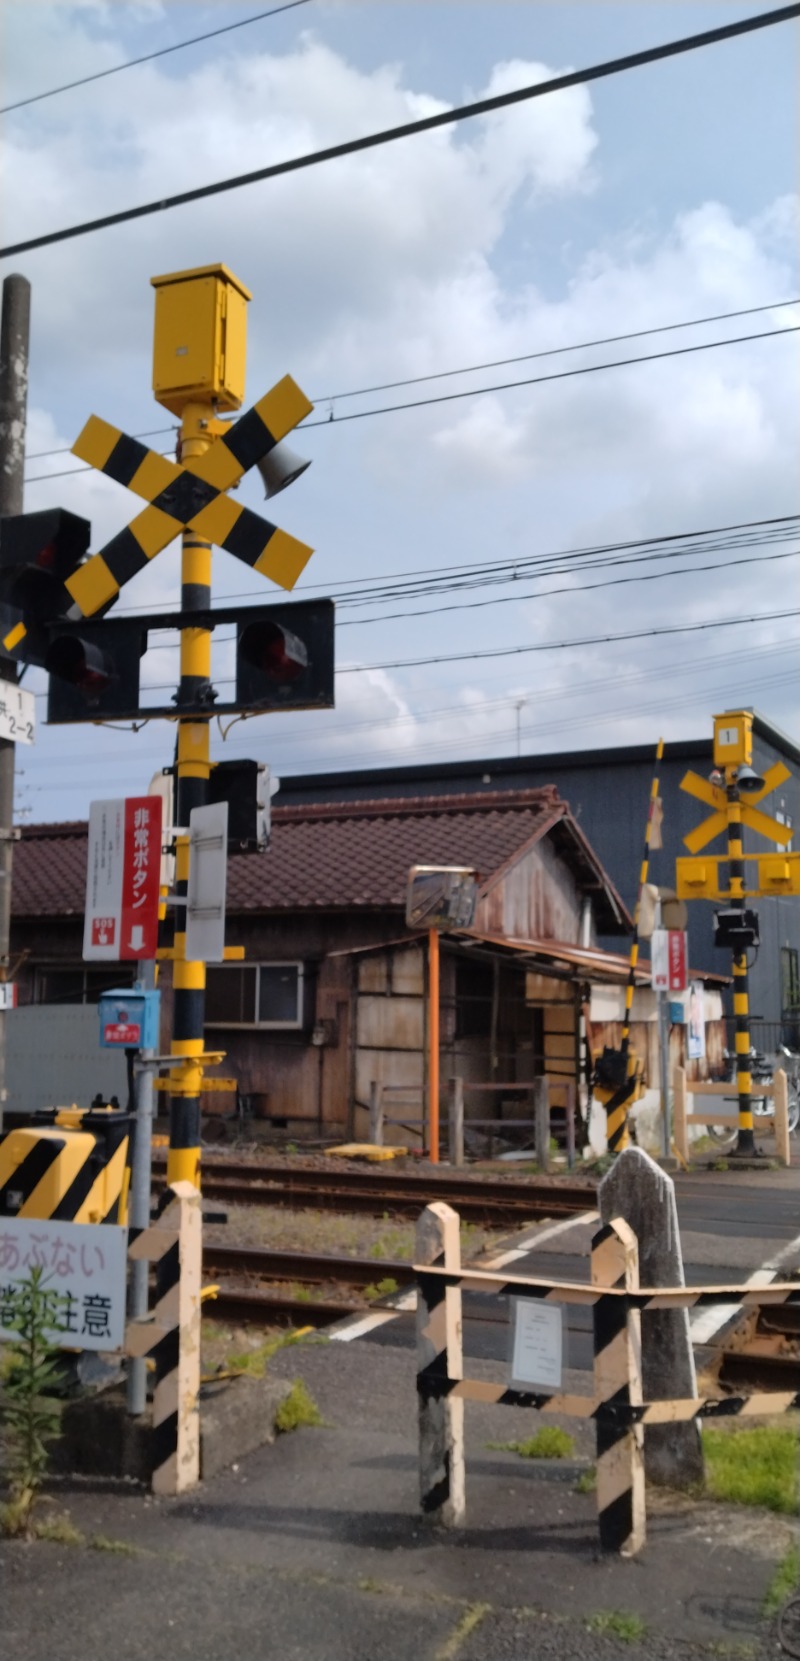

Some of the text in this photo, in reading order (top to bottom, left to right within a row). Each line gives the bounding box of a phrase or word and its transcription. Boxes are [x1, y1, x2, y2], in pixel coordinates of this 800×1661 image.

[725, 730, 731, 743] 1
[132, 807, 150, 909] 非常ボタン
[94, 918, 114, 929] SOS
[0, 1232, 106, 1278] あぶない
